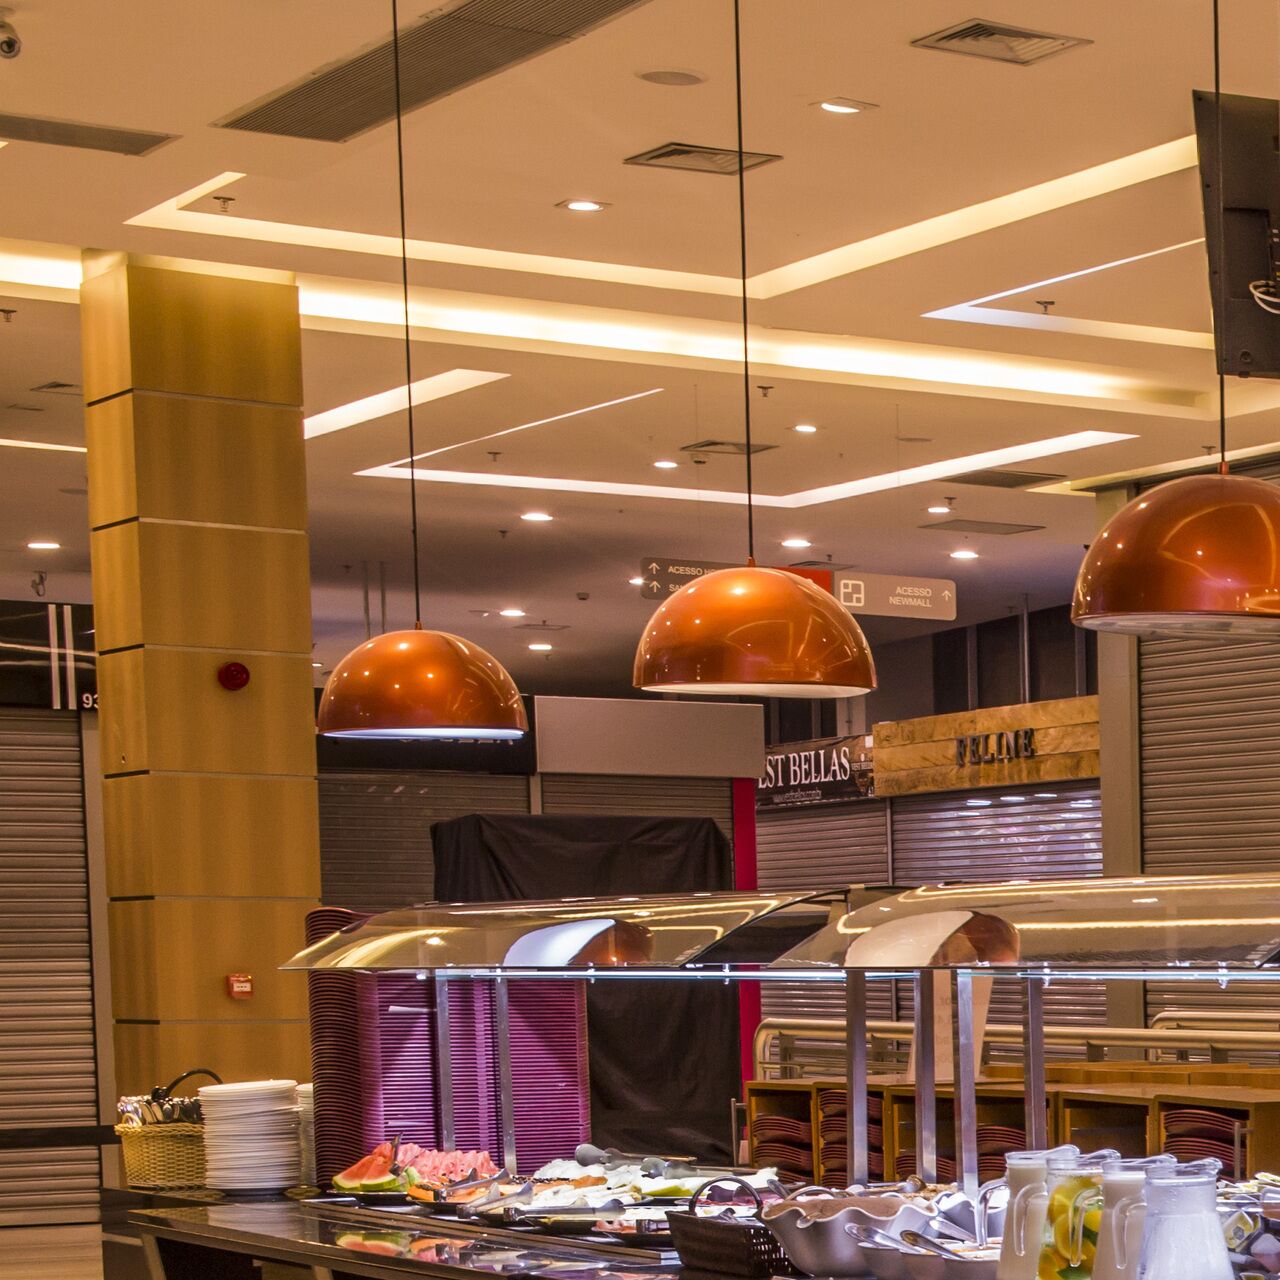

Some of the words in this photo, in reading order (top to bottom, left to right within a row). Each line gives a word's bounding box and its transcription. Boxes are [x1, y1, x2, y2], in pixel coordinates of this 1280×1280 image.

[667, 565, 703, 577] ACESSO
[895, 586, 932, 597] ACESSO
[888, 596, 932, 608] NEWMALL
[956, 728, 1035, 767] FELINE
[788, 747, 850, 786] BELLAS
